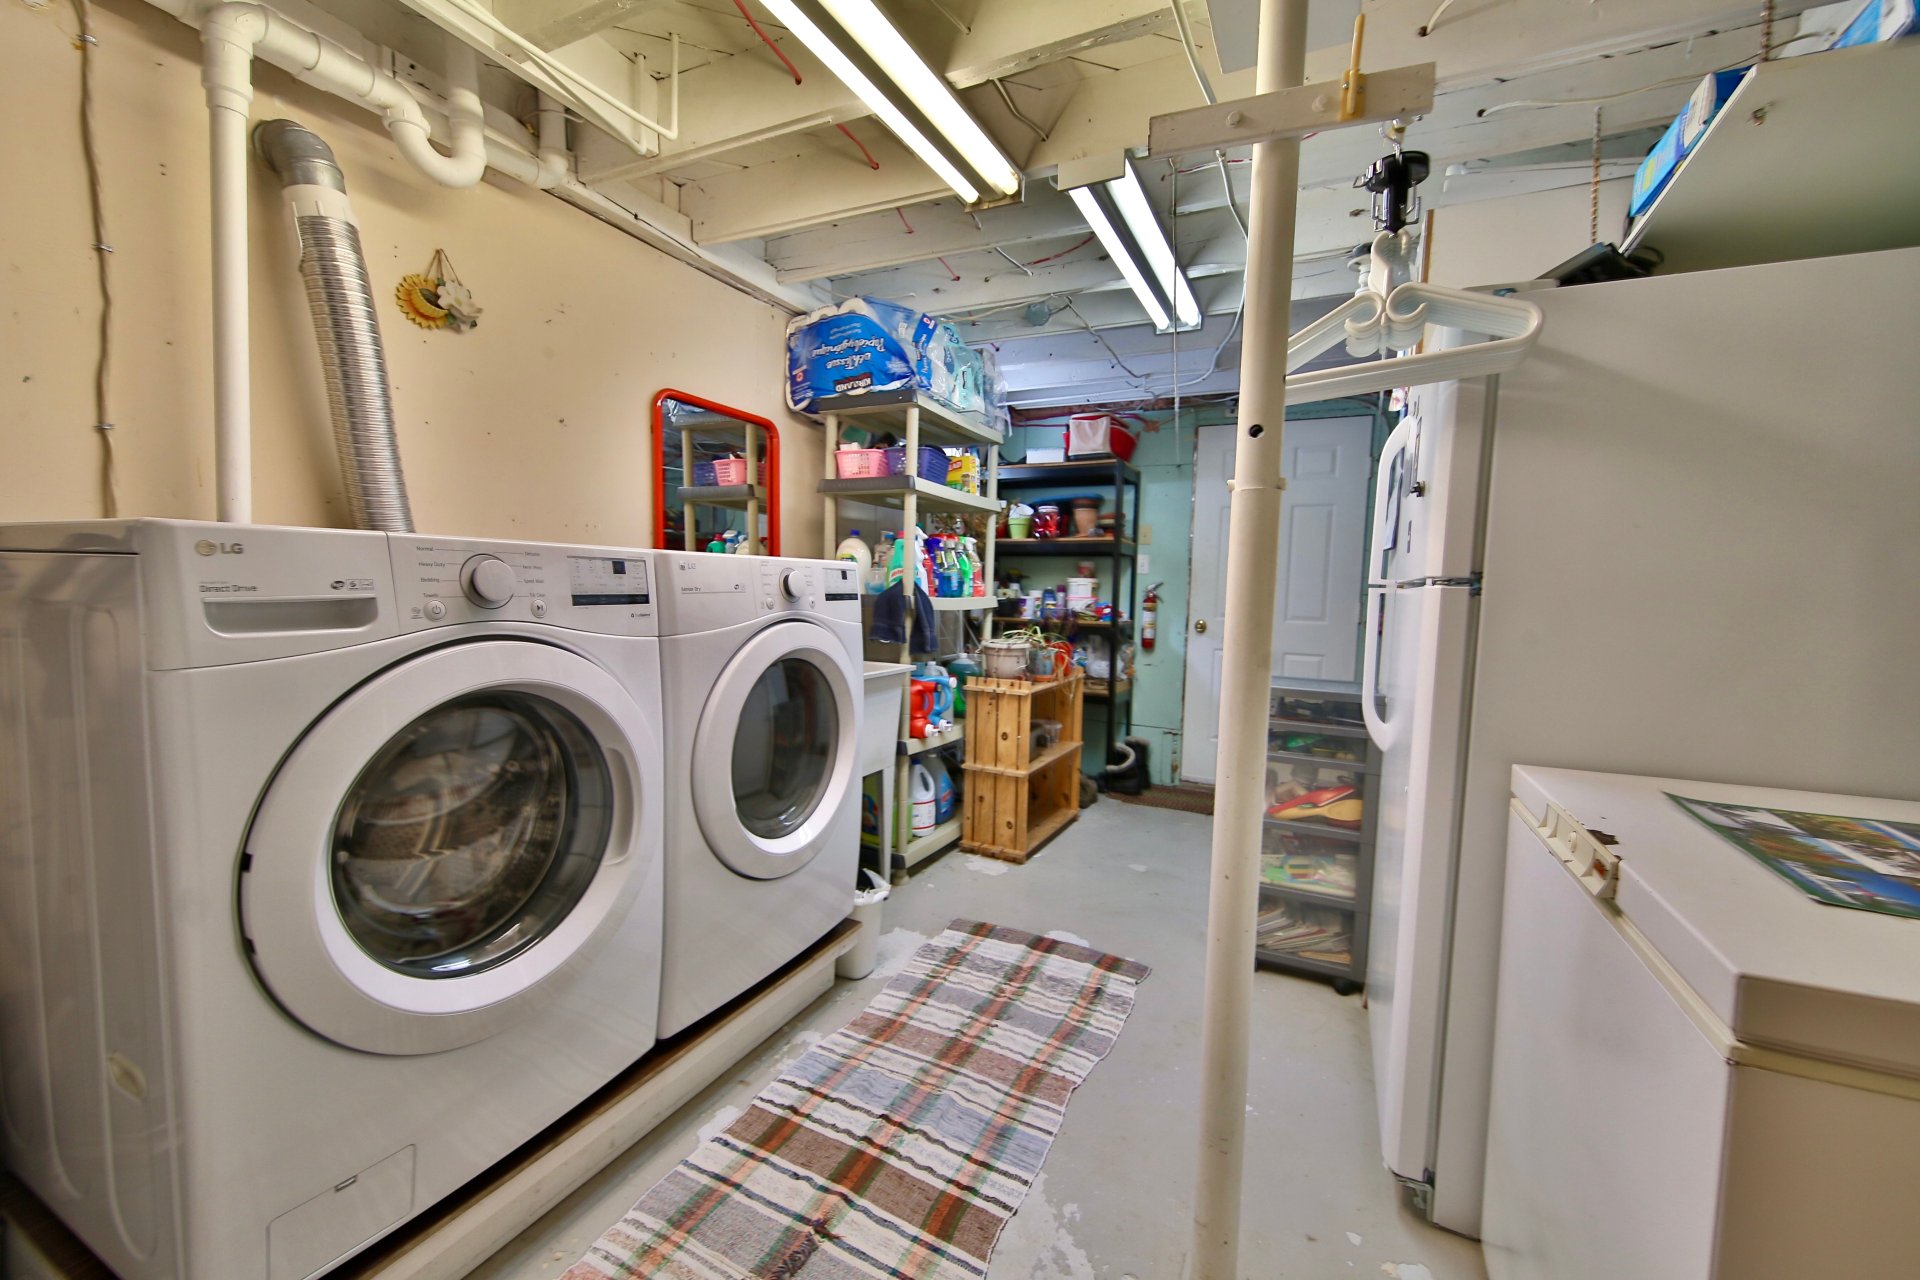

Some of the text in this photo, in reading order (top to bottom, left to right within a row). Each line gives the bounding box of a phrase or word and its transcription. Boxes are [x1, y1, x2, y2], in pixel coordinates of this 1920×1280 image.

[220, 542, 244, 554] LG
[199, 584, 257, 593] Direct Drive
